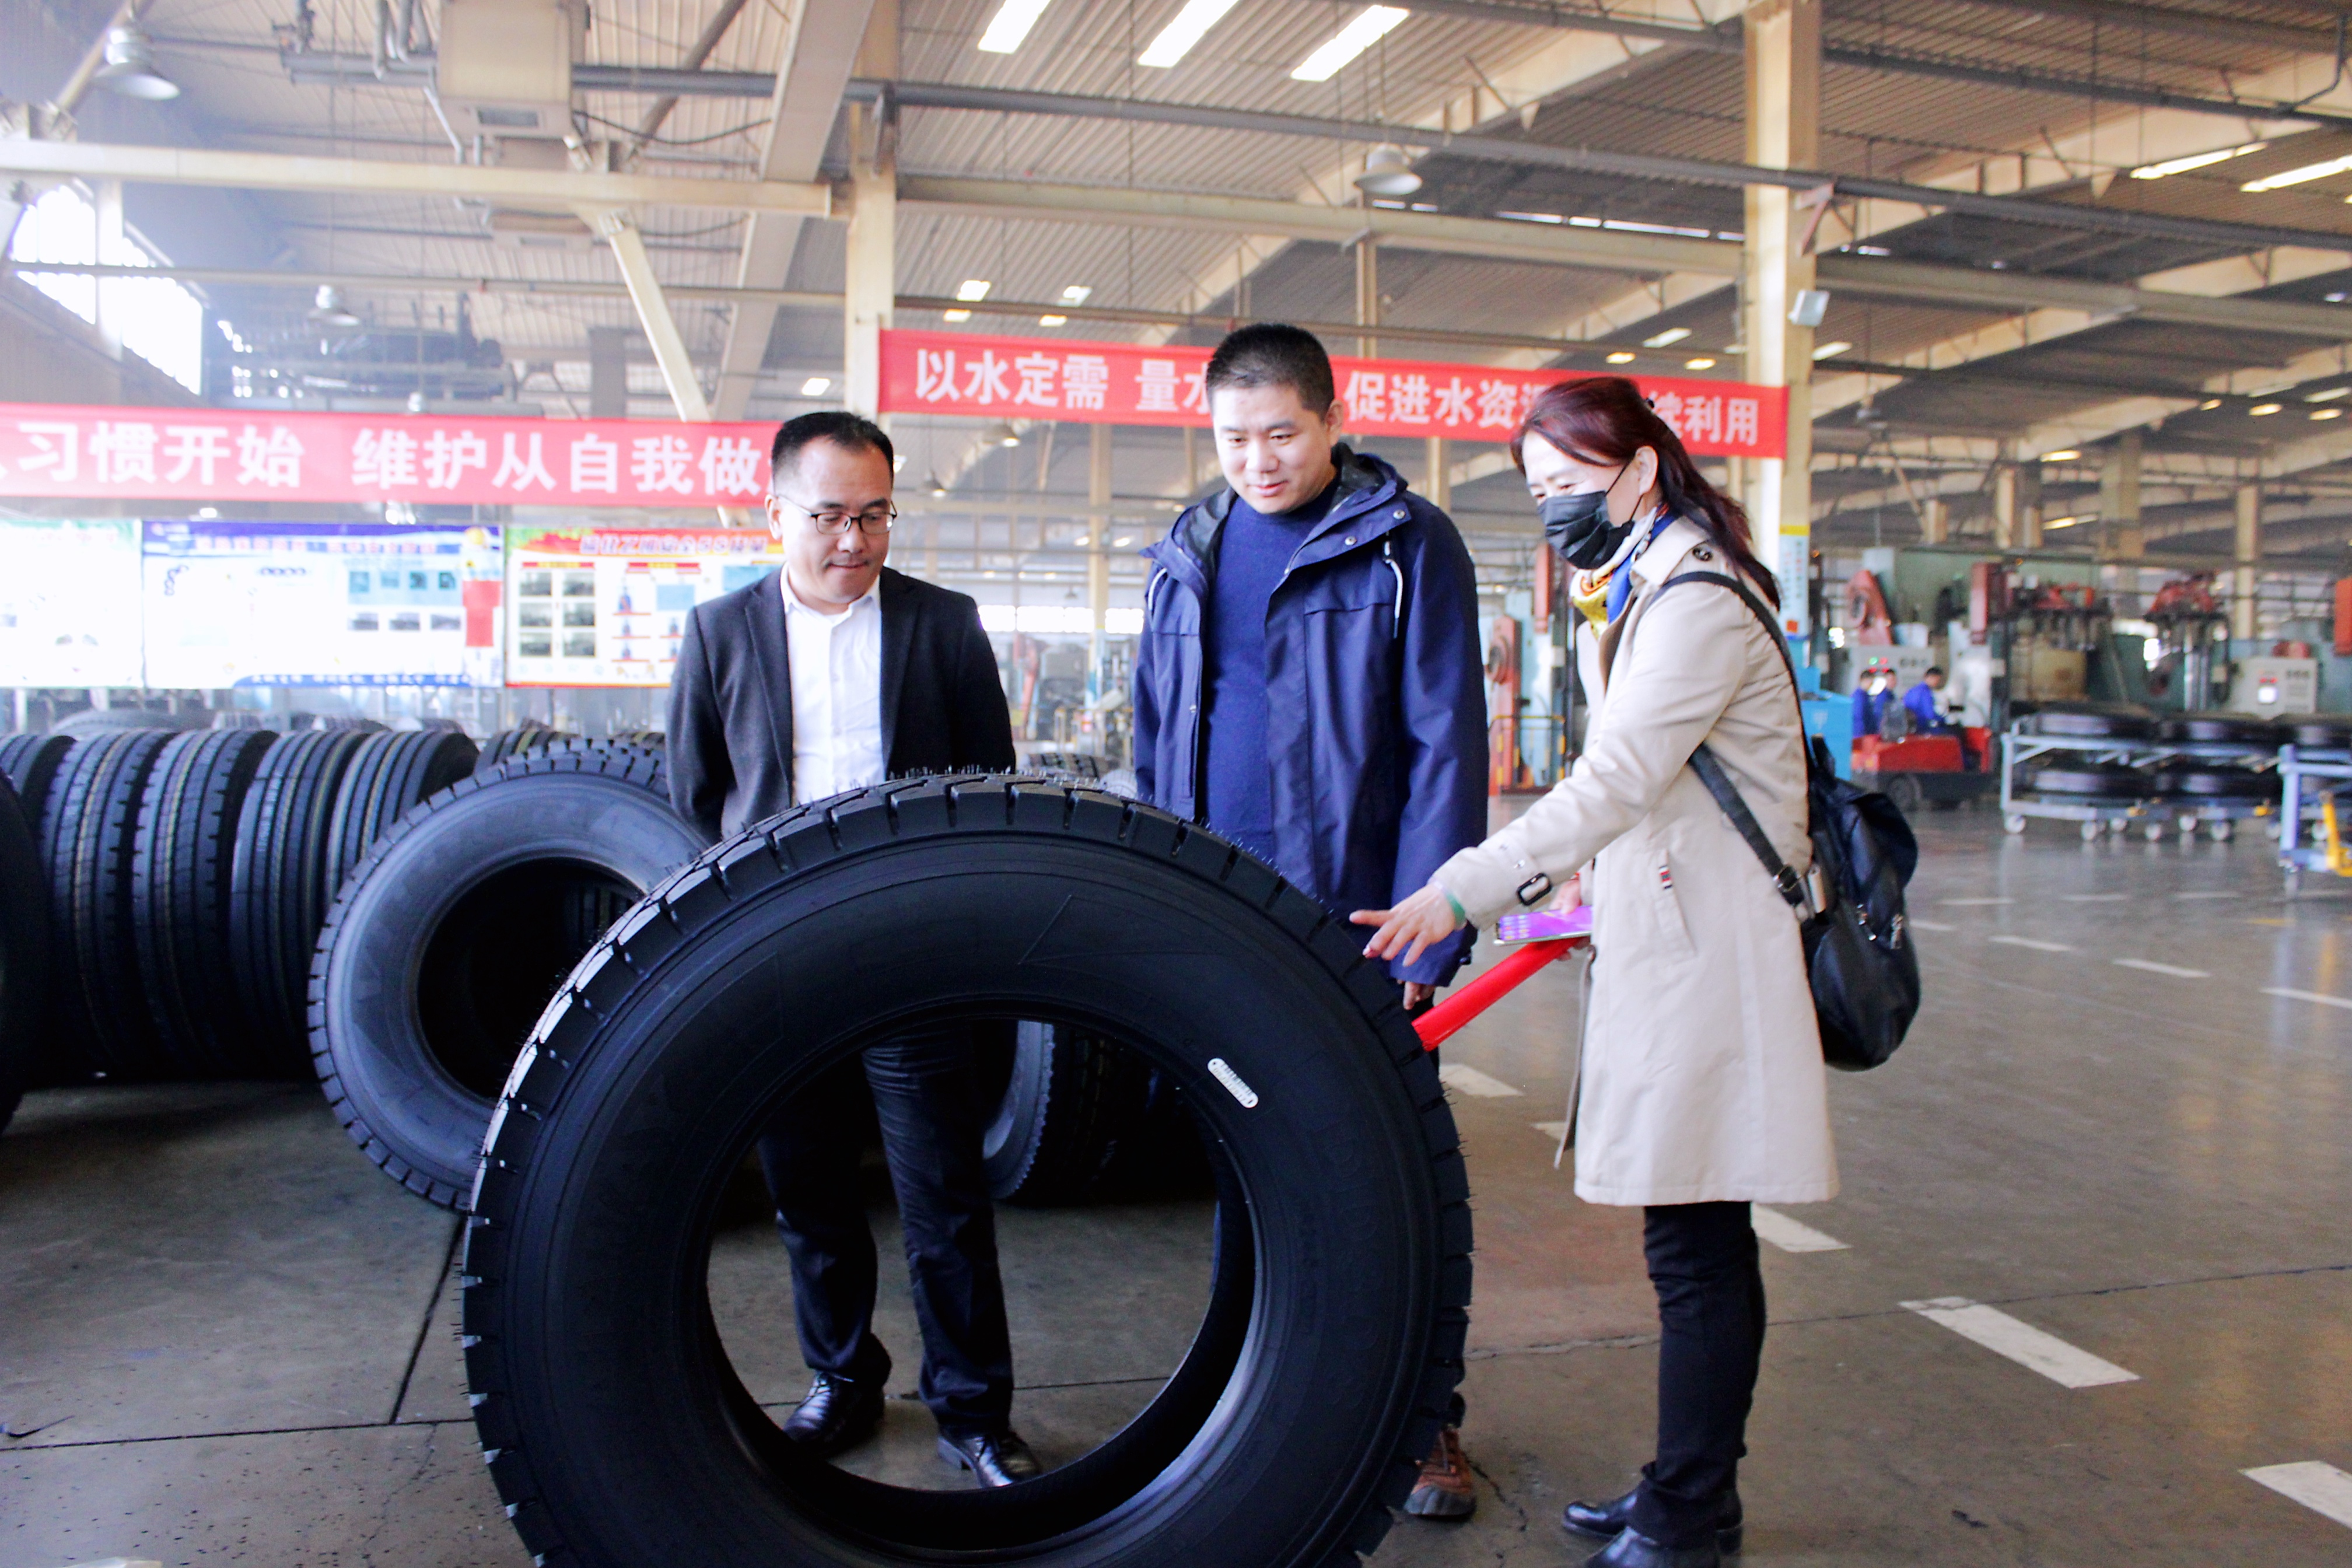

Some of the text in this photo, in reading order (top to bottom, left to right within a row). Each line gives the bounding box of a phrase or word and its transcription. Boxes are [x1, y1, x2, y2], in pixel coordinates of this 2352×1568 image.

[915, 348, 1110, 411] 以水定需
[0, 420, 775, 496] 习惯开始 维护从自我做
